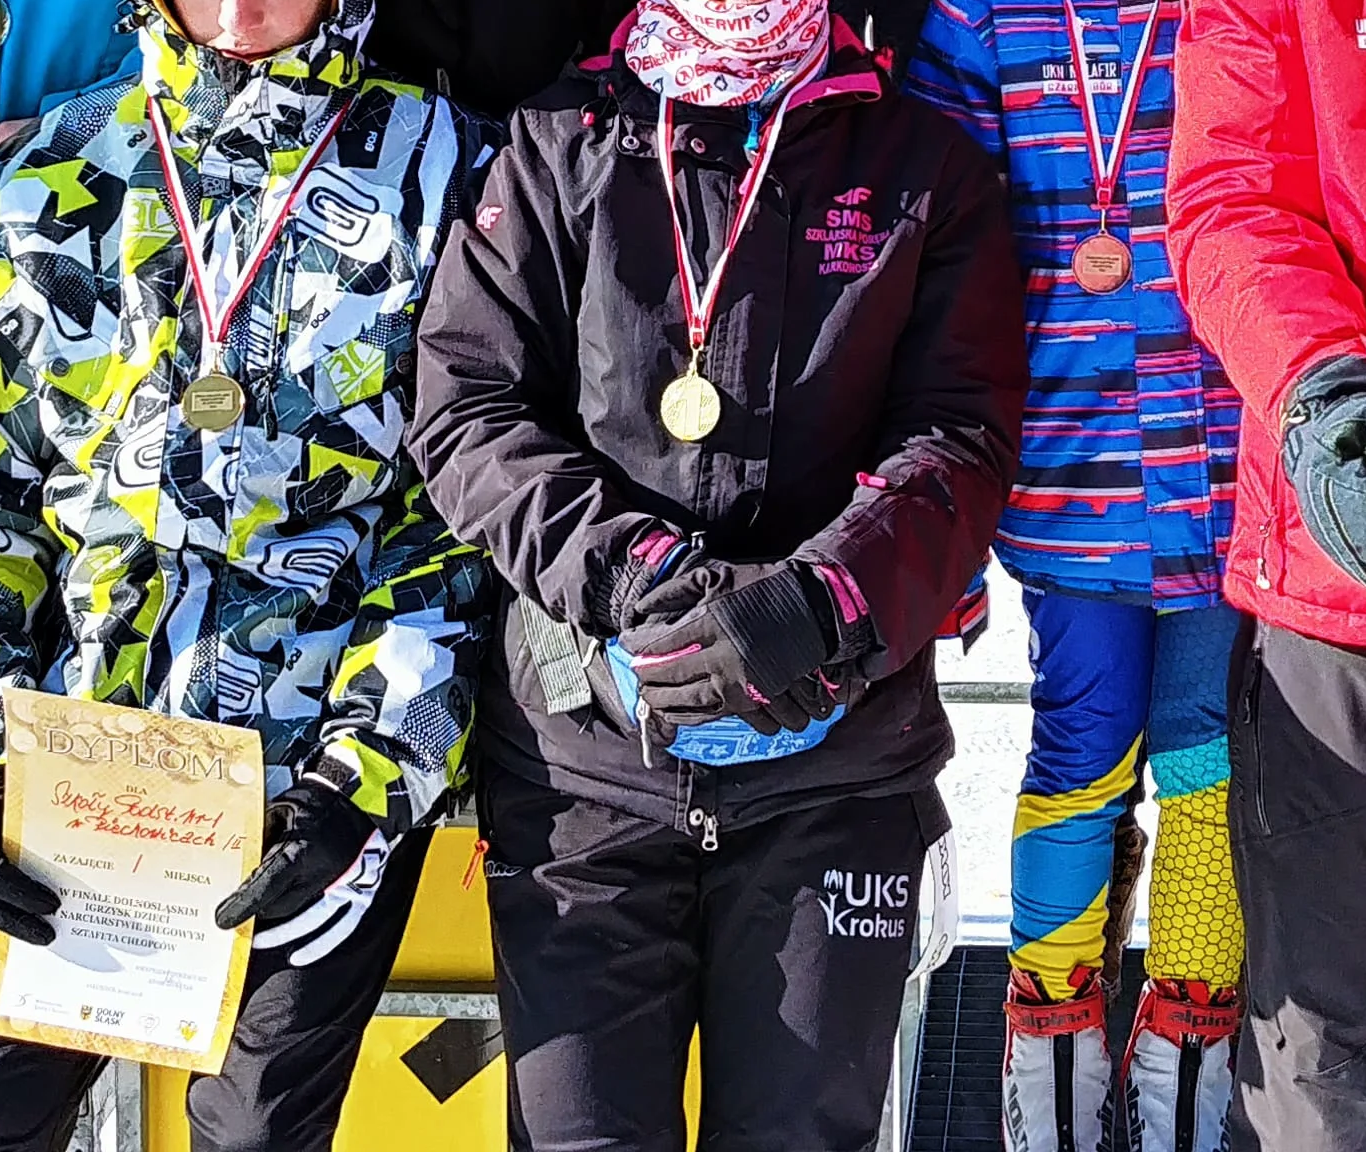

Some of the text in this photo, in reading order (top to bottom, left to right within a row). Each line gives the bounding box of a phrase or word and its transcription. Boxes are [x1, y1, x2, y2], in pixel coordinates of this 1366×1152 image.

[826, 209, 872, 232] SMS
[823, 241, 875, 261] MKS
[46, 728, 226, 781] DYPLOM
[126, 784, 148, 795] DLA
[53, 852, 68, 864] ZA
[164, 869, 212, 886] MIEJSCA
[59, 887, 71, 897] W
[72, 889, 111, 904] FINALE
[845, 871, 910, 908] UKS
[85, 902, 170, 924] IGRZYSK DZIECI
[828, 908, 905, 938] Krokus
[60, 910, 206, 942] NARCIARSTWIE BIEGOWYM
[71, 927, 119, 943] SZTAFETA
[97, 1007, 126, 1019] DOLNY
